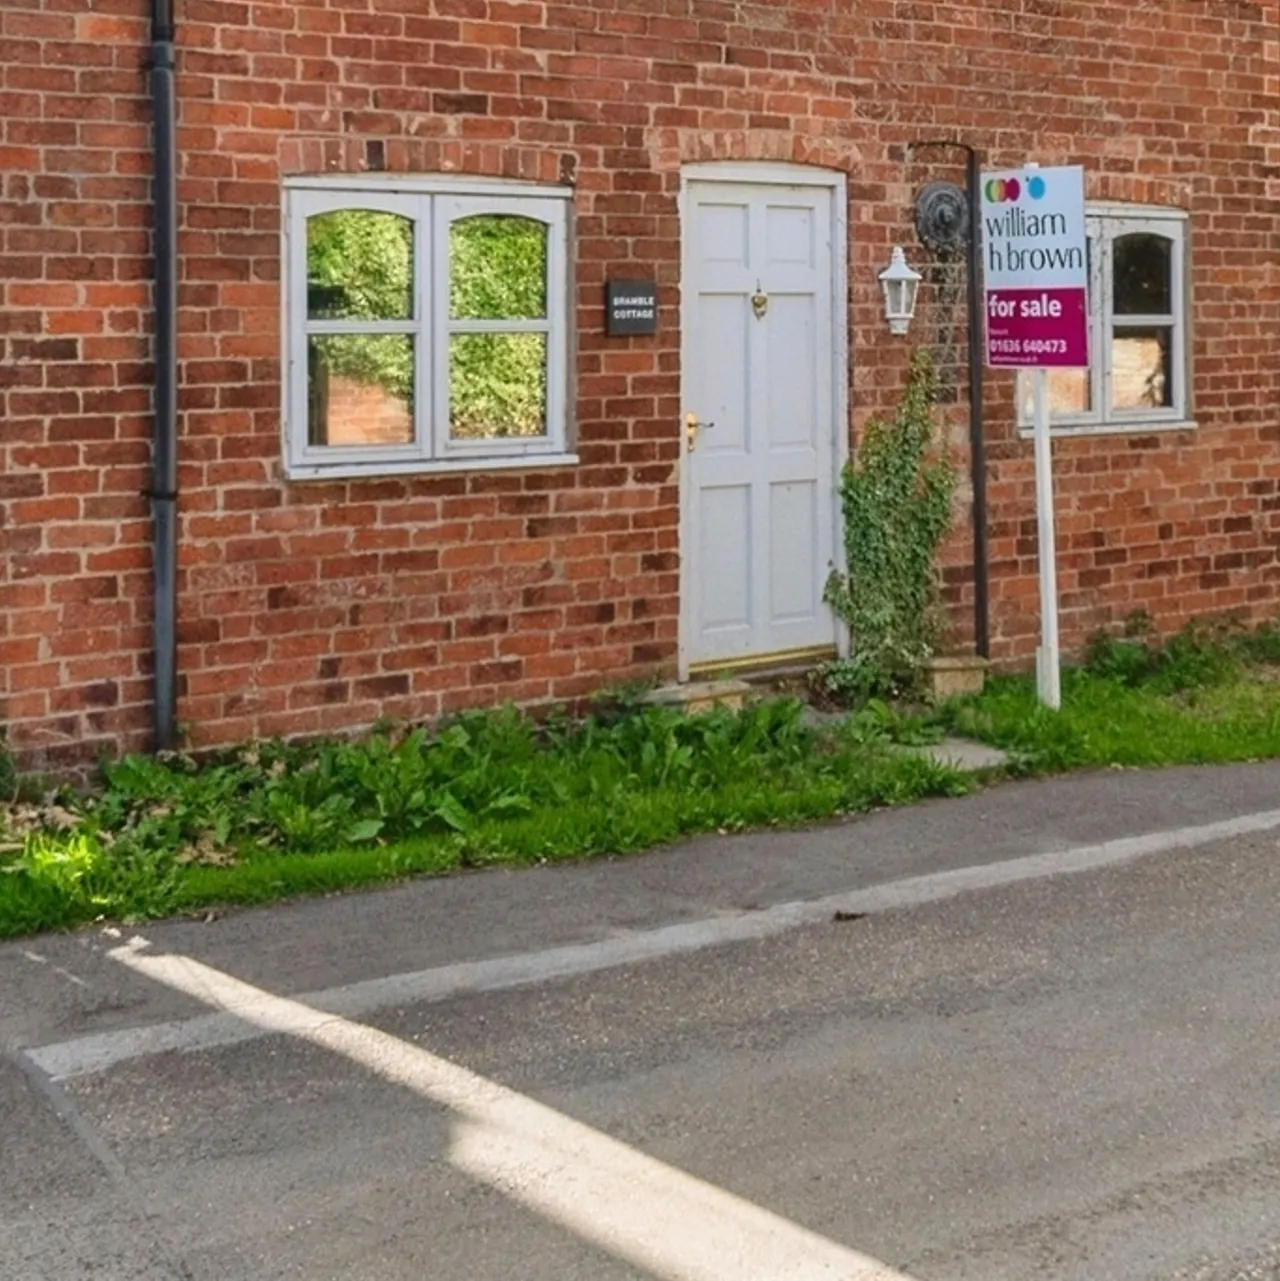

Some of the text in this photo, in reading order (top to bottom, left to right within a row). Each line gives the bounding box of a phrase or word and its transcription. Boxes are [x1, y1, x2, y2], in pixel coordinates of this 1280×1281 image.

[986, 207, 1066, 236] william
[989, 241, 1082, 272] h brown
[613, 296, 654, 306] BRAMBLE
[989, 292, 1062, 318] for sale
[613, 309, 653, 319] COTTAGE
[1022, 338, 1068, 354] 640473
